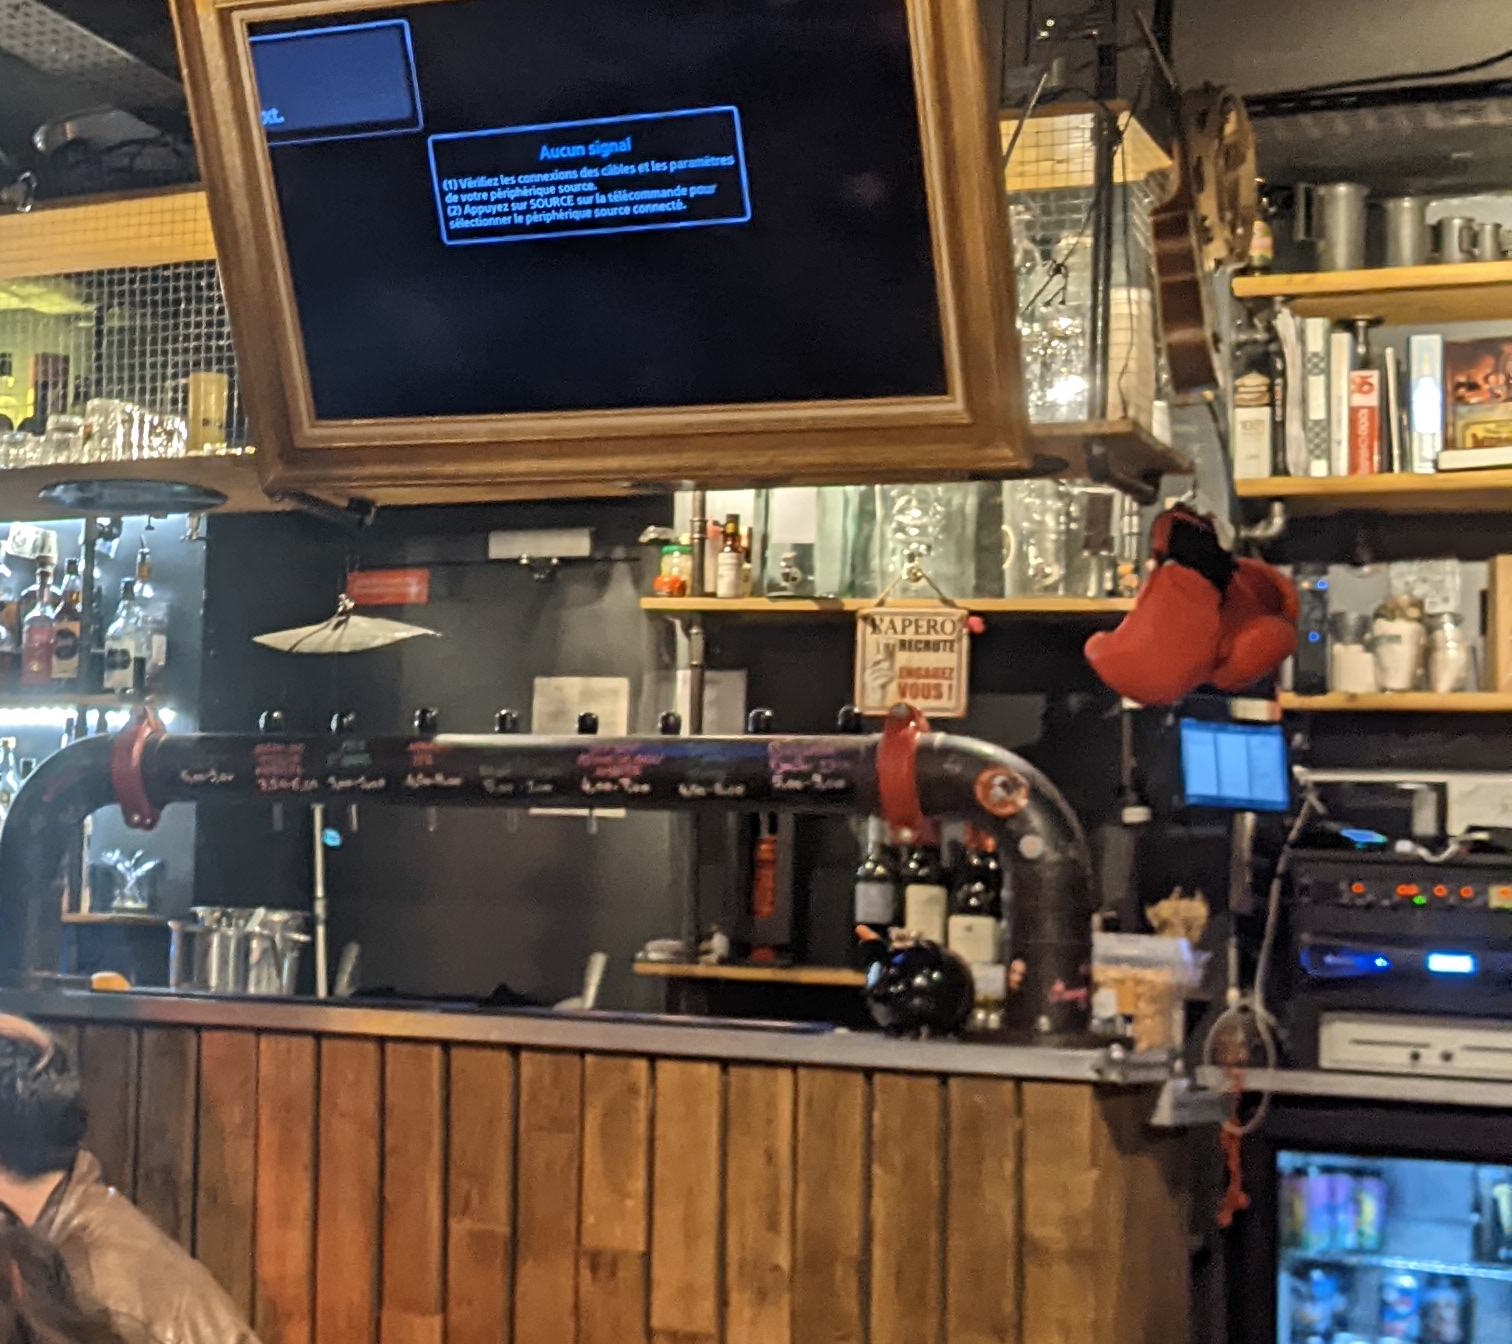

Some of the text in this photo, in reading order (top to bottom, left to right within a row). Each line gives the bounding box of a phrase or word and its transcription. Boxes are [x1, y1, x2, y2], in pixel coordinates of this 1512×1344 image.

[539, 136, 632, 161] Aucun signal
[443, 154, 735, 192] (1) Vérifiez les connexions des câbles et les paramètres
[445, 182, 598, 204] de votre périphérique source.
[447, 183, 718, 217] (2) Appuyez sur SOURCE sur la télécommande pour
[449, 199, 687, 230] sélectionner le périphérique source connecté.
[870, 617, 957, 636] L'APERO
[898, 639, 955, 653] RECRUTE
[898, 682, 943, 700] VOUS
